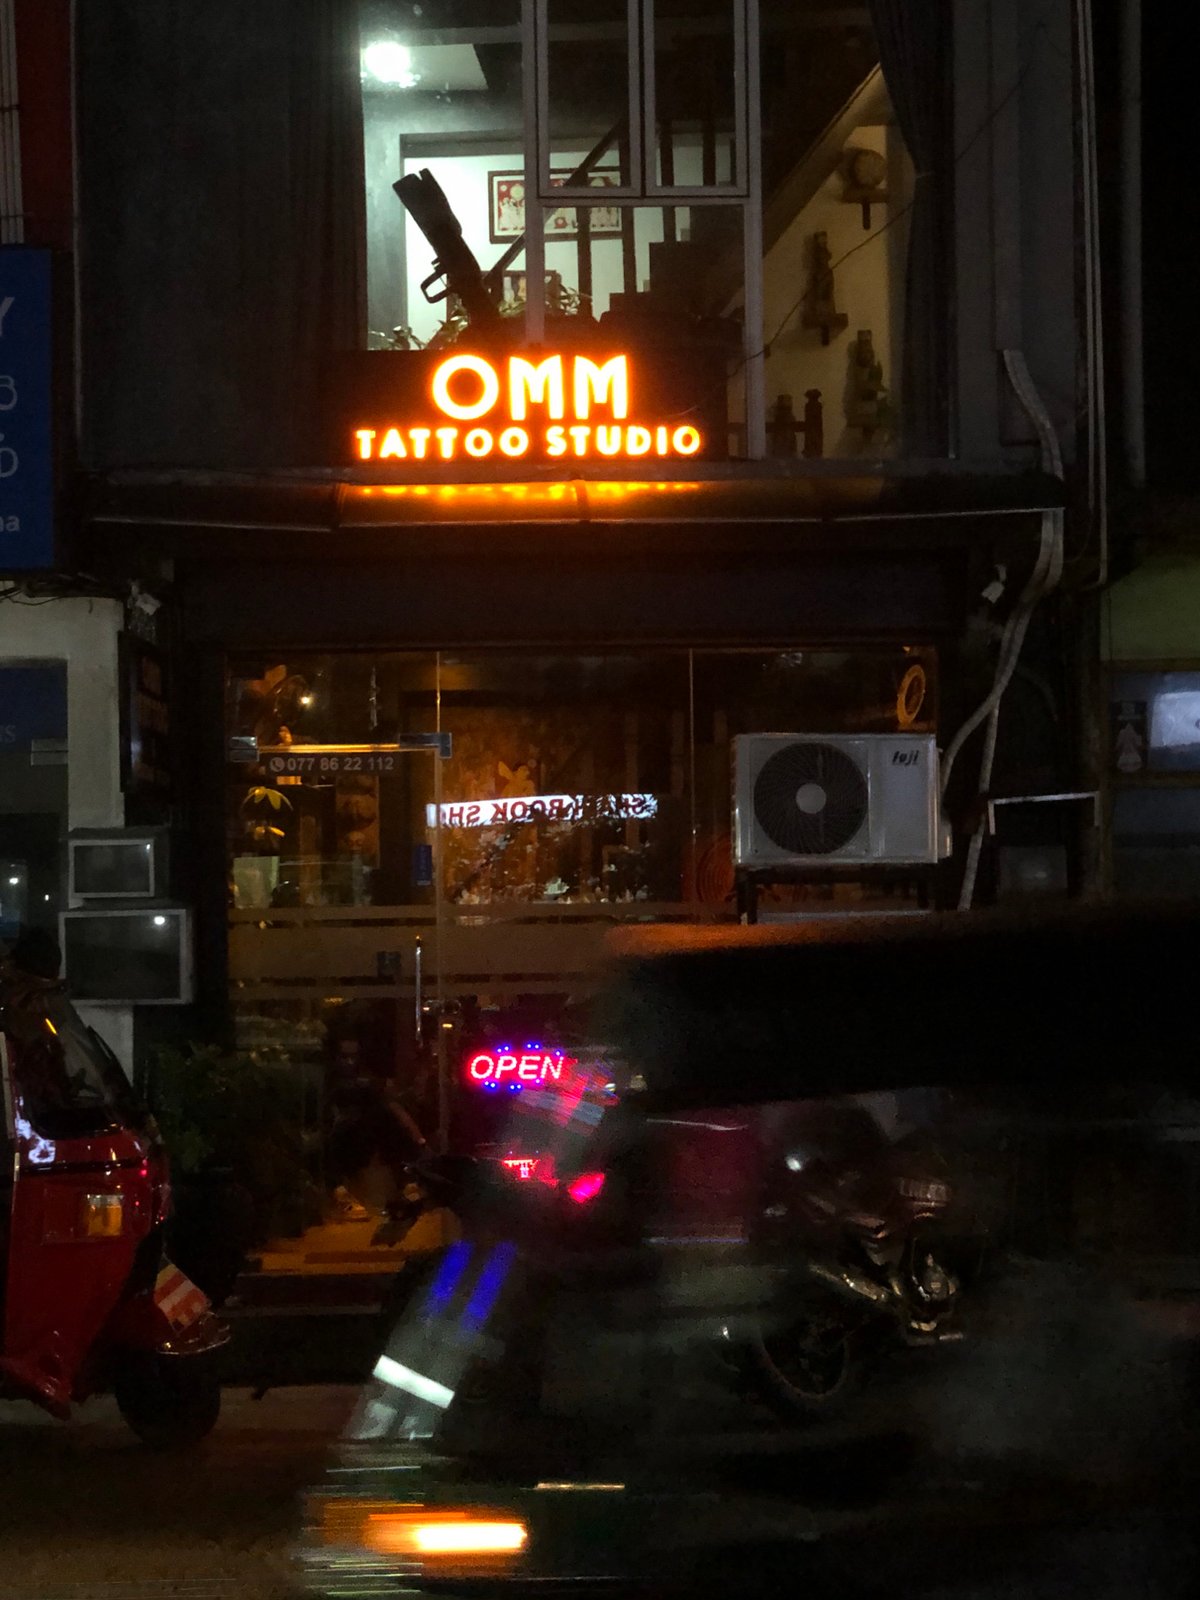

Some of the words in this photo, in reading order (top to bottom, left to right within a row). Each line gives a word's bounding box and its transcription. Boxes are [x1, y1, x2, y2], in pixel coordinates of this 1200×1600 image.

[432, 354, 628, 420] OMM
[356, 426, 529, 459] TATTOO
[546, 425, 701, 456] STUDIO
[287, 757, 313, 771] 077
[320, 757, 338, 771] 86
[344, 757, 361, 771] 22
[368, 757, 394, 771] 112
[470, 1055, 564, 1079] OPEN
